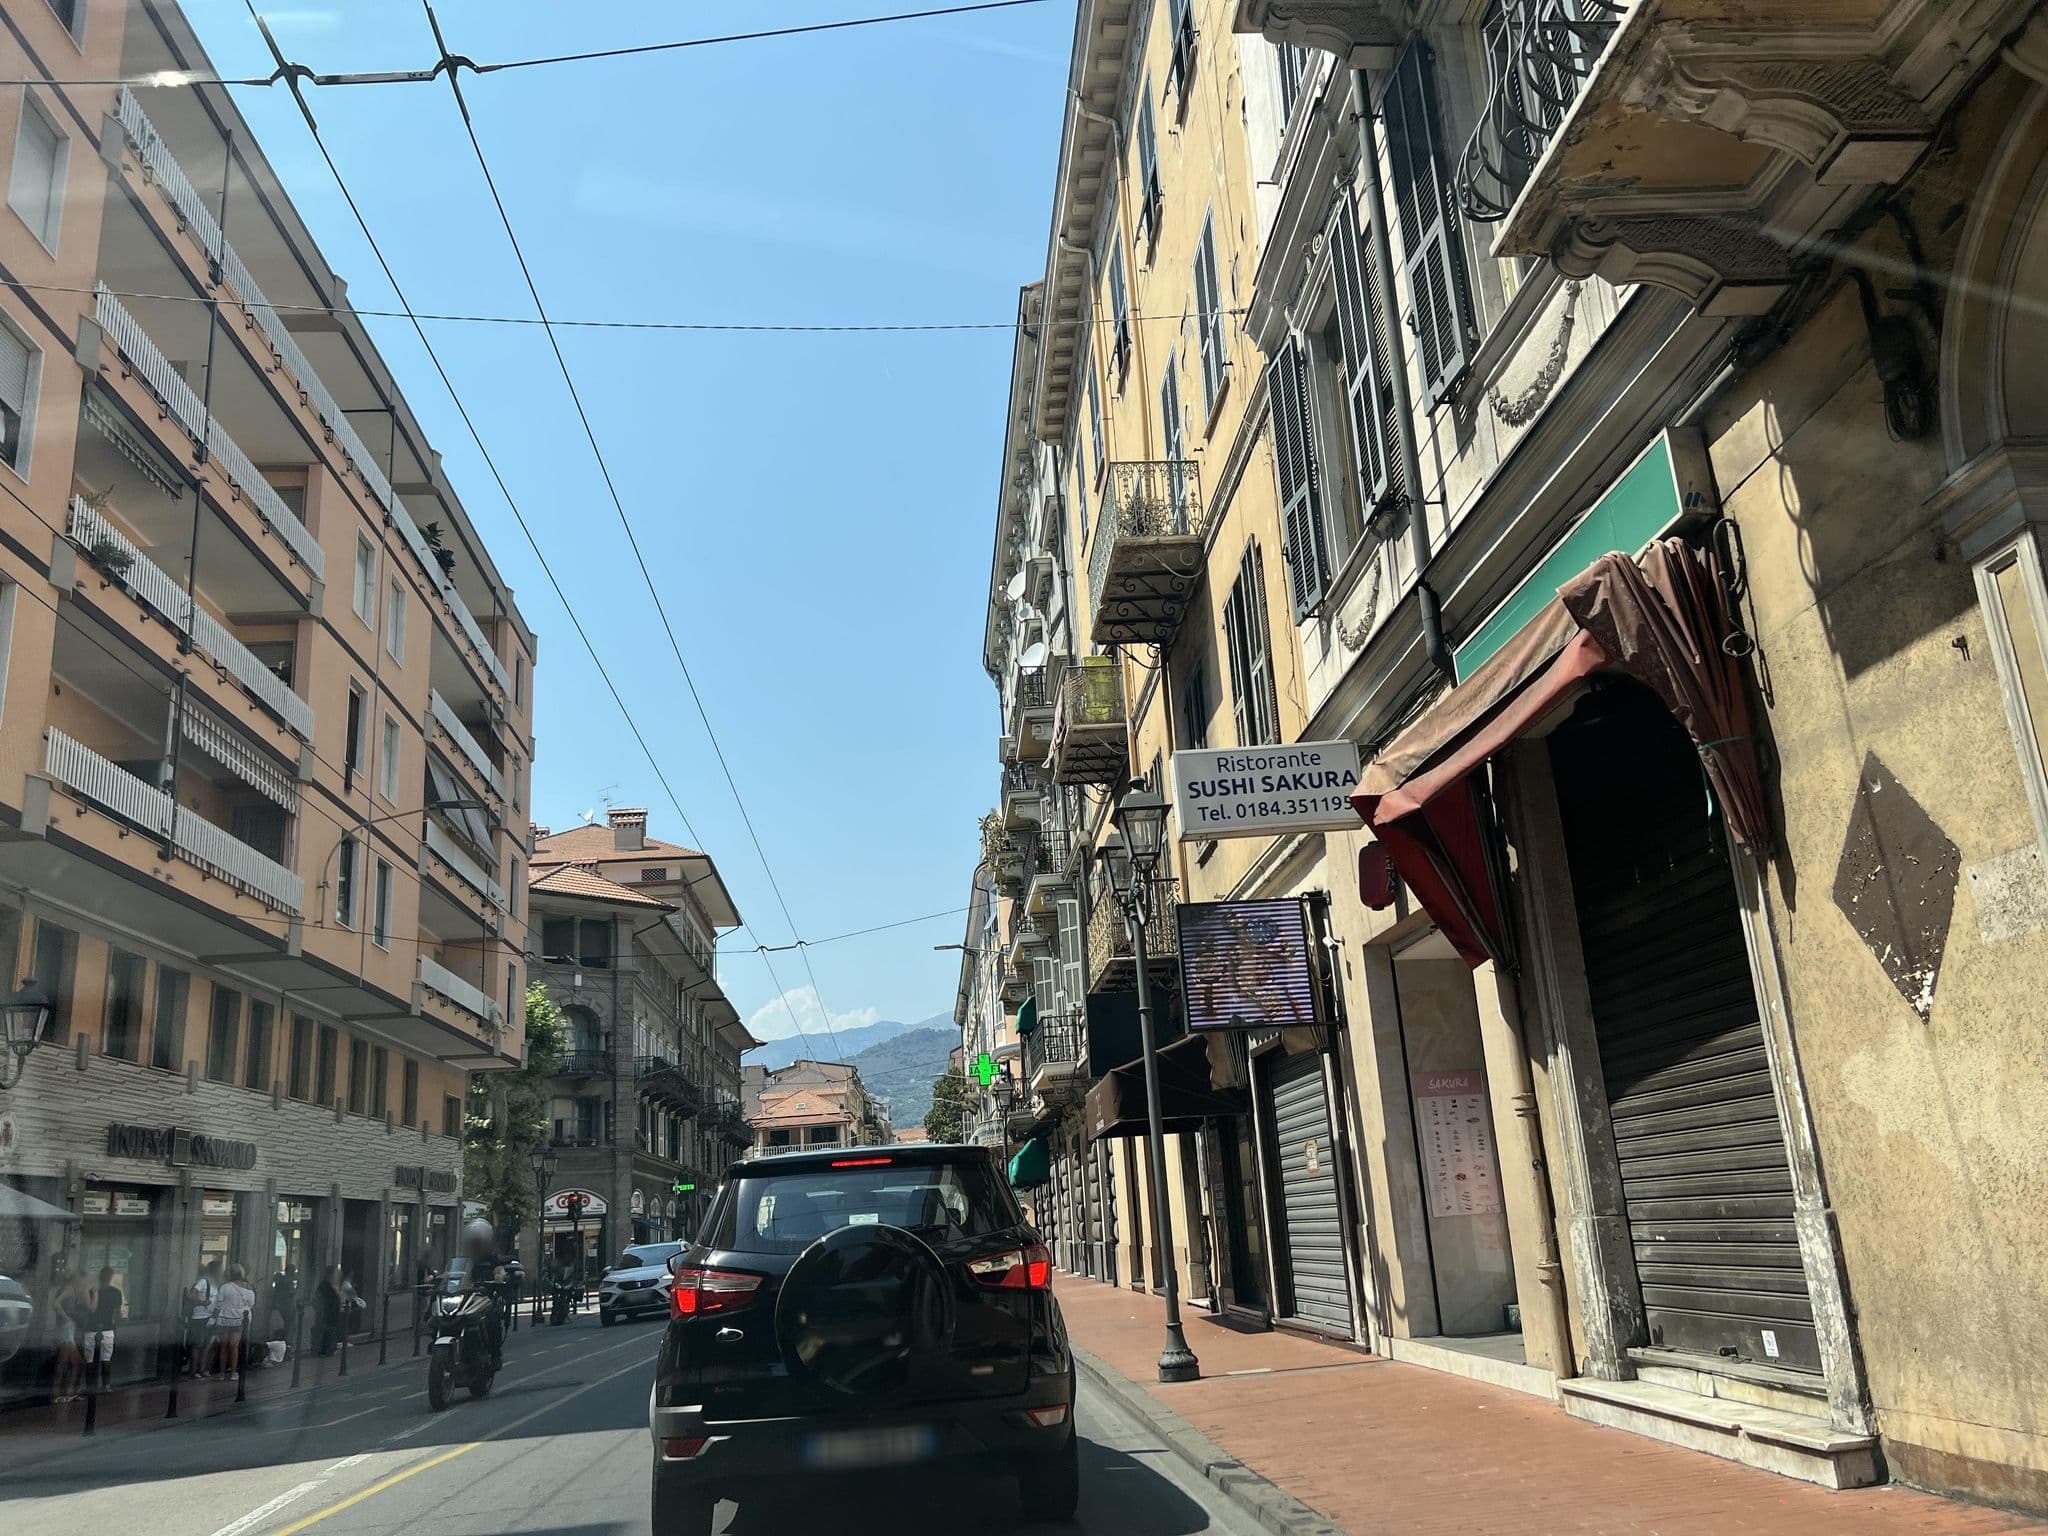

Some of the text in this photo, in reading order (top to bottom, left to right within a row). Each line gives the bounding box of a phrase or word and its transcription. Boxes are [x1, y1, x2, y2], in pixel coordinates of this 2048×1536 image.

[1217, 751, 1321, 773] Ristorante
[1188, 769, 1359, 799] SUSHI SAKURA
[1198, 795, 1354, 821] Tel. 0184.351195
[1428, 1077, 1469, 1090] SAKURA
